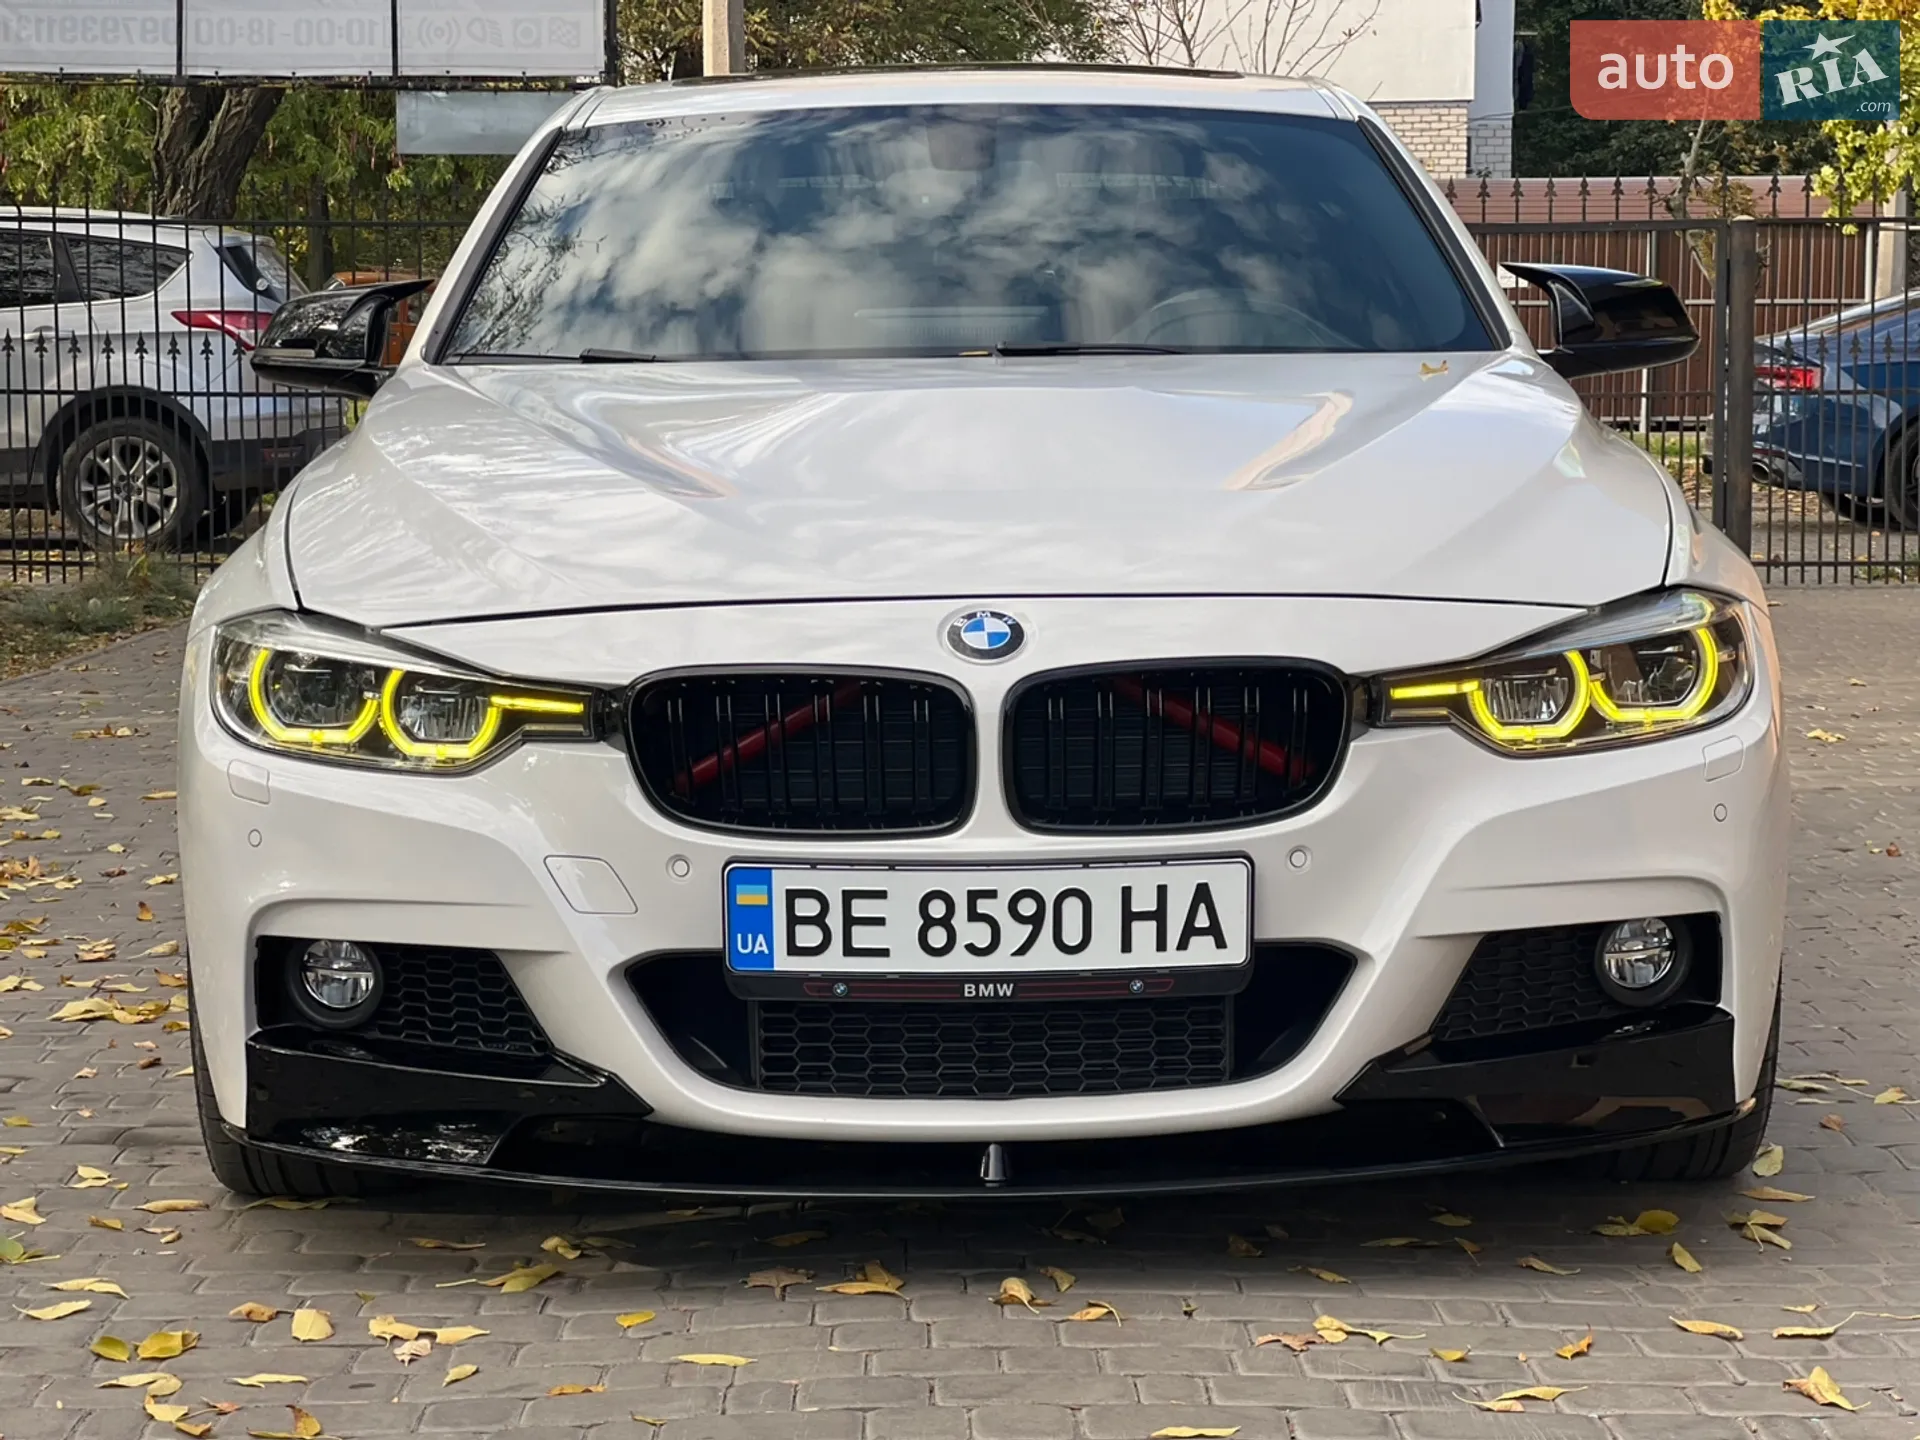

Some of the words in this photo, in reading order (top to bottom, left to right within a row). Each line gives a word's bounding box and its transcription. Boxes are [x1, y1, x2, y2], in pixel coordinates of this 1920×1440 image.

[953, 611, 1017, 627] BMW
[784, 887, 891, 958] BE
[917, 886, 1093, 958] 8590
[1120, 882, 1228, 954] HA
[736, 933, 770, 955] UA
[963, 982, 1014, 998] BMW
